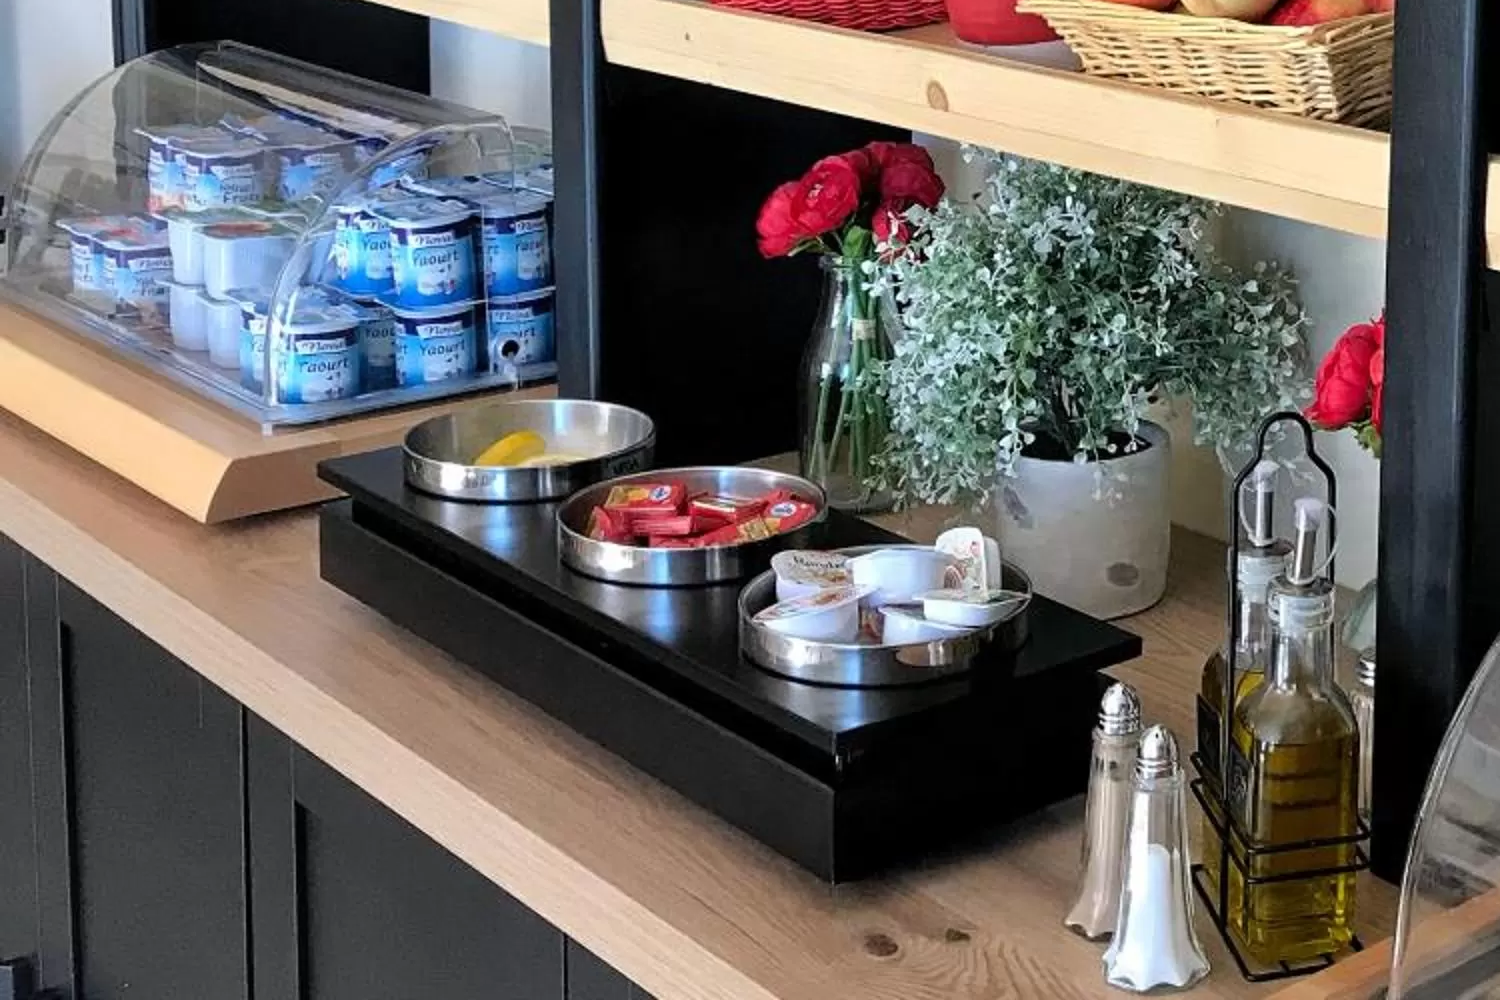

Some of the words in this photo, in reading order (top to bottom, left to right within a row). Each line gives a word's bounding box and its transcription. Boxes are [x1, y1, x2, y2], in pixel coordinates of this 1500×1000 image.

[413, 249, 460, 266] Yaourt
[420, 339, 465, 357] Yaourt
[300, 357, 350, 373] Yaourt
